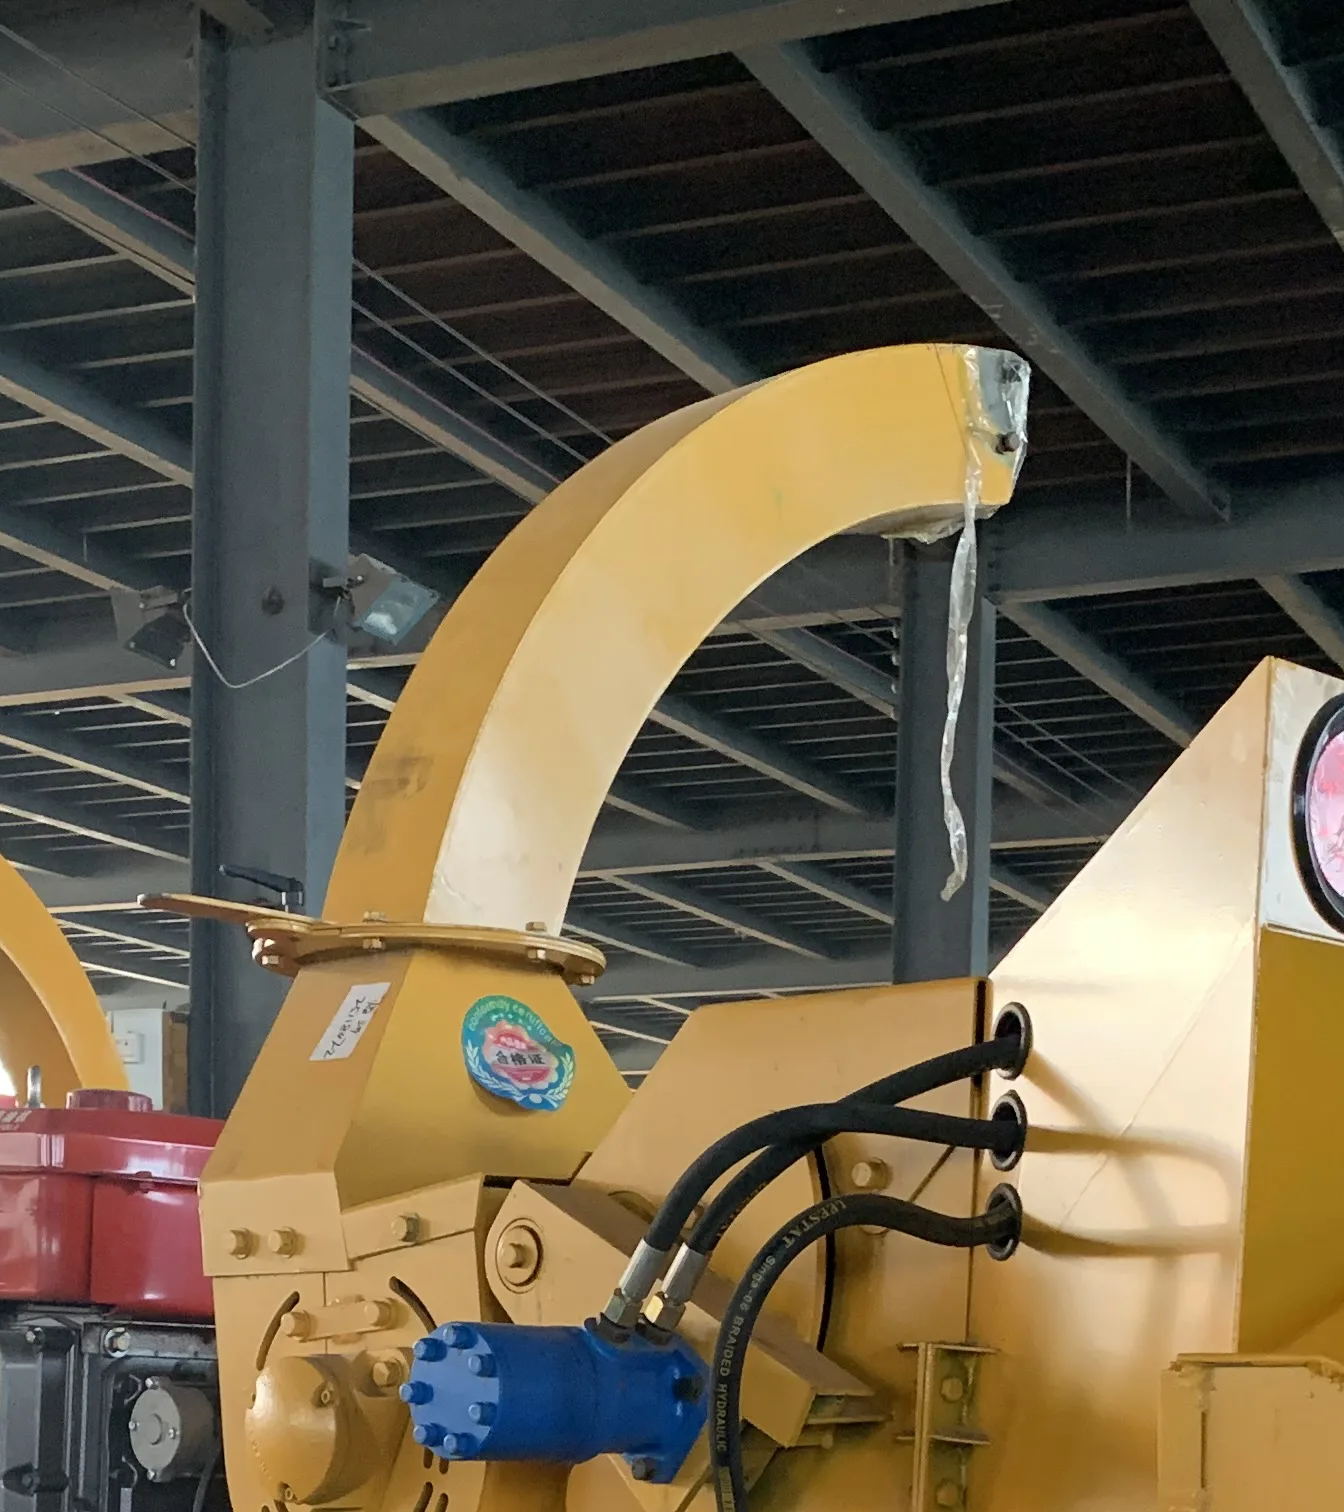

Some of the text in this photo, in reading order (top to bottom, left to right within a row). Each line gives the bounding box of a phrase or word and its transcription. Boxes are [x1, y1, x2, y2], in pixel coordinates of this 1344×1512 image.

[495, 1050, 547, 1066] 合格证
[719, 1314, 745, 1377] BRAIDED
[714, 1383, 729, 1452] HYDRAULIC
